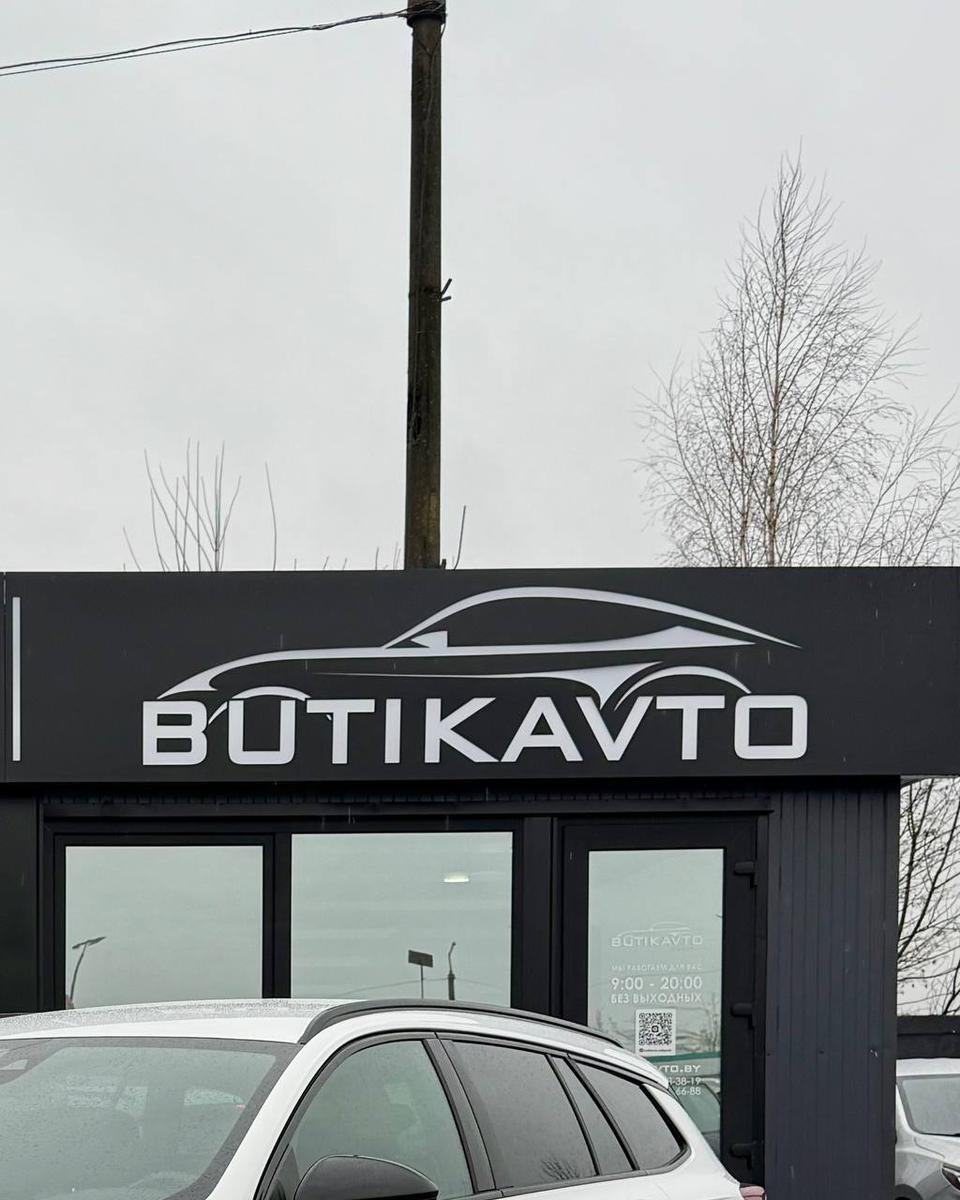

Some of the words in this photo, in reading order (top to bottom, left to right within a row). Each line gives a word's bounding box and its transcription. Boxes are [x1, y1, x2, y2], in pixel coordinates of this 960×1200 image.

[142, 693, 808, 766] BUTIKAVTO
[611, 935, 703, 947] BUTIKAVTO
[611, 976, 643, 991] 9:00
[659, 975, 703, 990] 20:00
[611, 993, 630, 1004] БЕЗ
[632, 992, 703, 1005] ВЫХОДНЫХ
